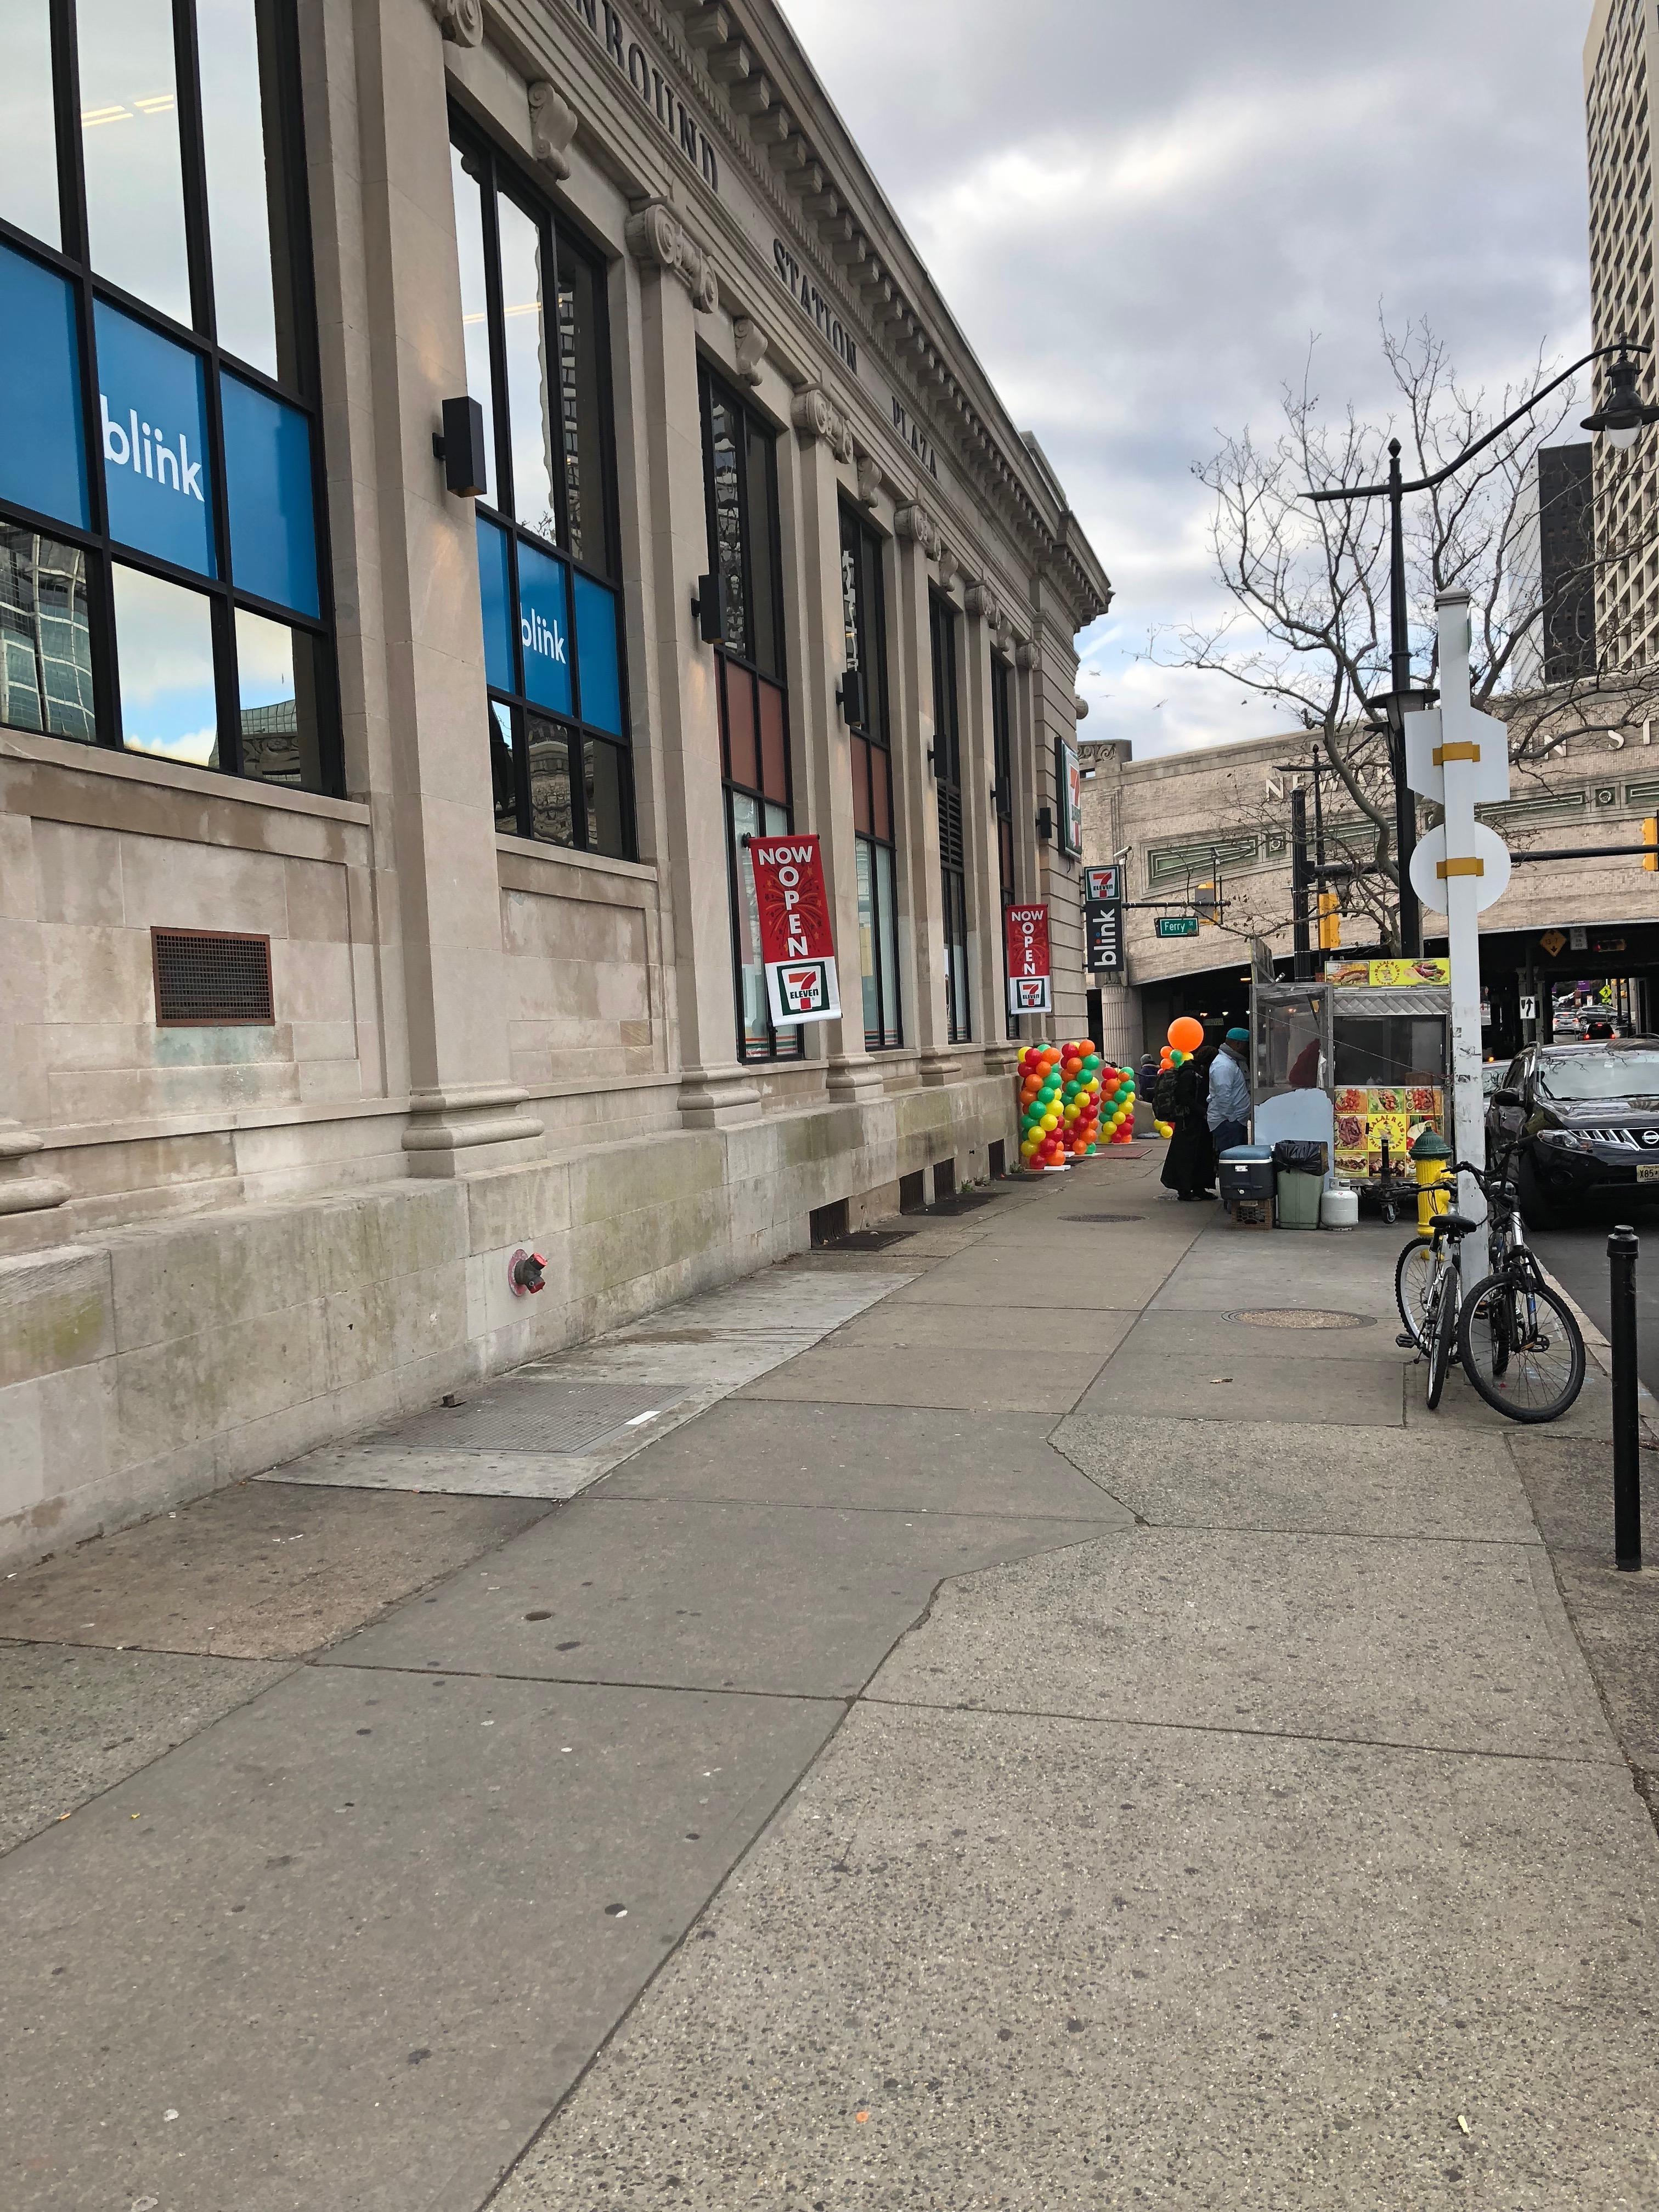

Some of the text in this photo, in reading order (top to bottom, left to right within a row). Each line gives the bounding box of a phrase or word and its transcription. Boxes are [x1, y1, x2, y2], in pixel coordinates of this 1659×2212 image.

[773, 238, 857, 375] STATION
[99, 393, 205, 503] blink
[520, 601, 566, 664] blink
[758, 845, 813, 865] NOW
[1093, 872, 1112, 898] 7
[778, 866, 809, 957] OPEN
[1011, 910, 1043, 921] NOW
[1093, 908, 1116, 966] blink
[1164, 922, 1185, 932] Ferry
[1022, 922, 1035, 975] OPEN
[1374, 961, 1390, 973] HALAL
[788, 971, 817, 1011] 7
[1023, 983, 1039, 1006] 7
[1369, 1115, 1390, 1132] HALAL
[1397, 1121, 1404, 1132] US
[1369, 1138, 1381, 1149] TRUS
[1639, 1168, 1654, 1178] X85
